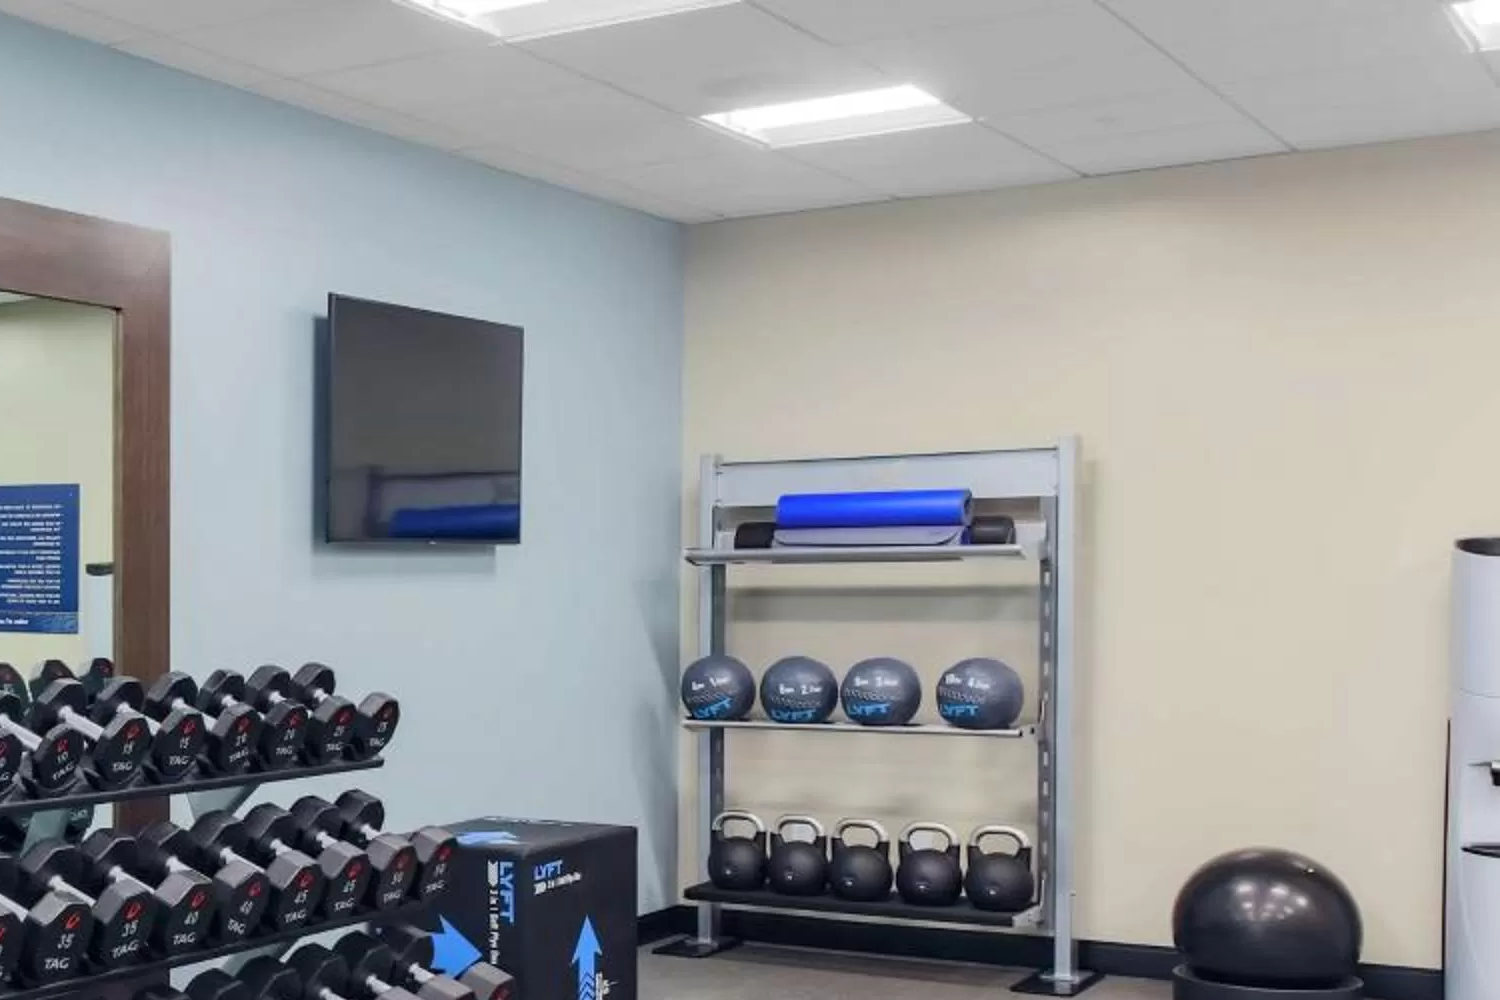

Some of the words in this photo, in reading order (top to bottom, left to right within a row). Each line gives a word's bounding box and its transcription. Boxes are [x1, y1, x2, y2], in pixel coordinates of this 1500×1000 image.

[111, 761, 134, 773] TAG
[167, 754, 190, 767] TAG
[533, 859, 564, 881] LYFT
[499, 860, 515, 924] LYFT
[283, 909, 308, 924] TAG
[121, 919, 139, 938] 35
[227, 917, 247, 936] TAG
[56, 932, 76, 950] 35
[172, 931, 197, 945] TAG
[111, 940, 140, 959] TAG
[43, 956, 70, 971] TAG
